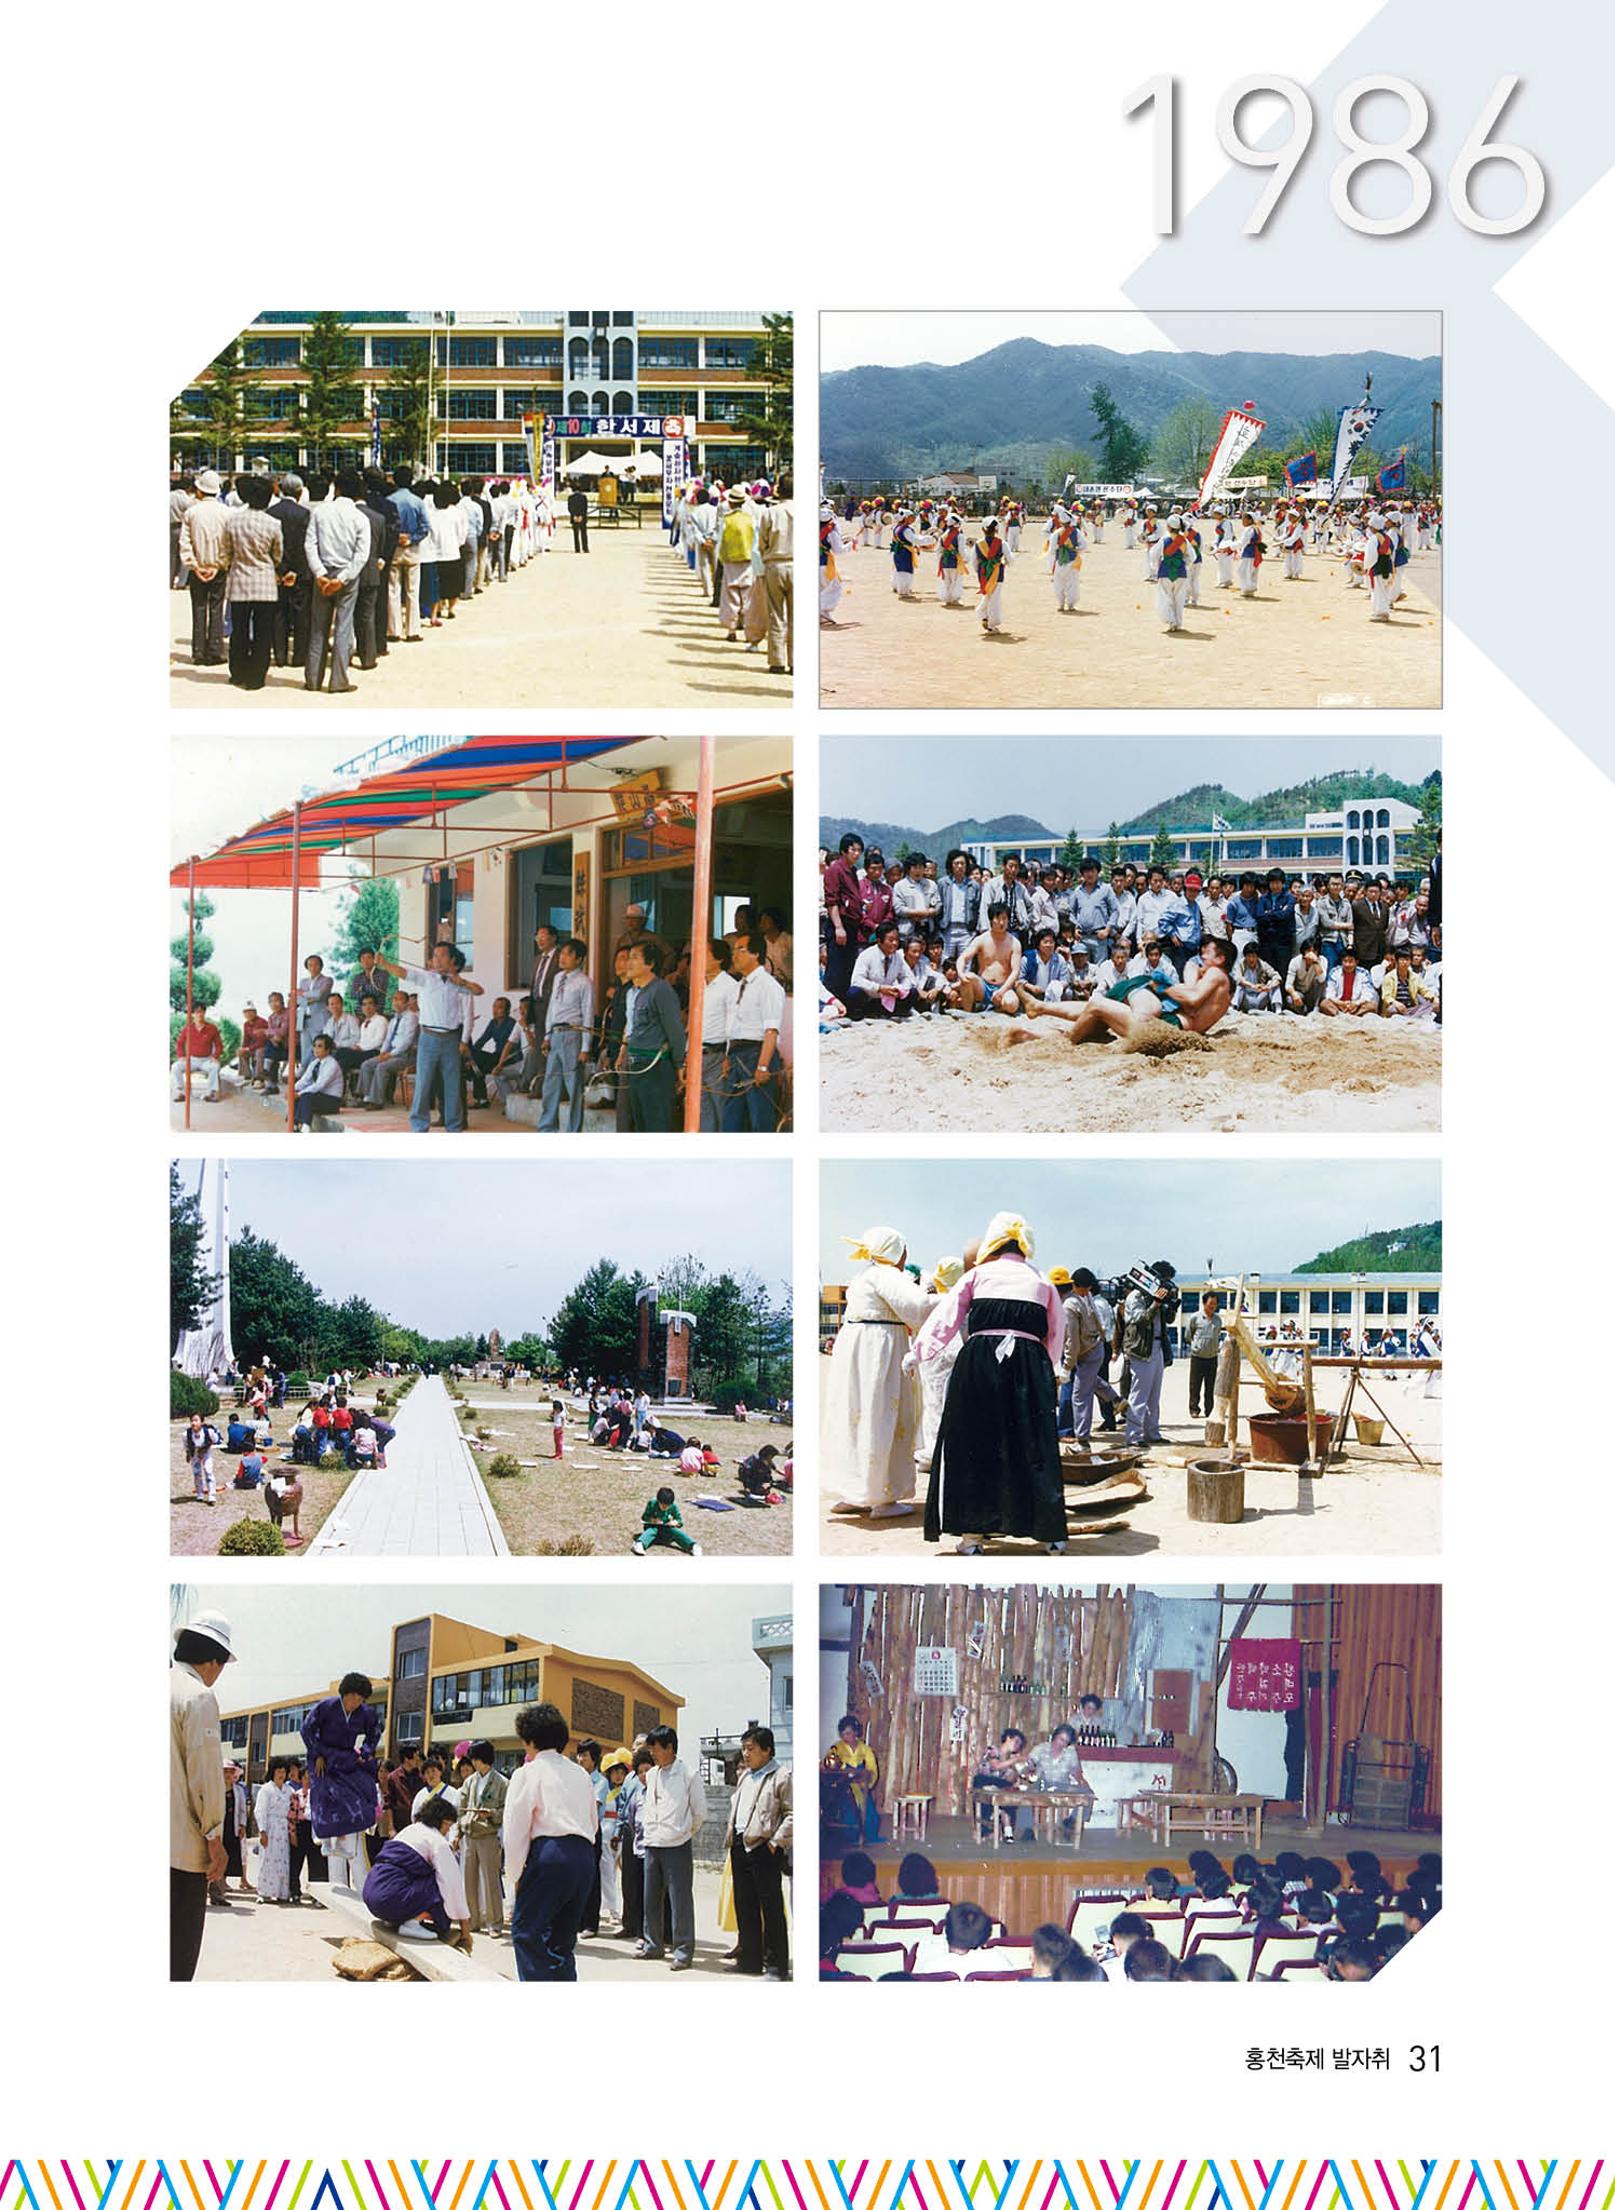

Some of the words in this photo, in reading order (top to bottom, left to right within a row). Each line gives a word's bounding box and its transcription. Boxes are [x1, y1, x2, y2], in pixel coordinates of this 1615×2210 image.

[1123, 73, 1546, 236] 1986
[1245, 2047, 1324, 2071] 홍천축제
[1332, 2047, 1390, 2071] 발자취
[1409, 2045, 1440, 2072] 31
